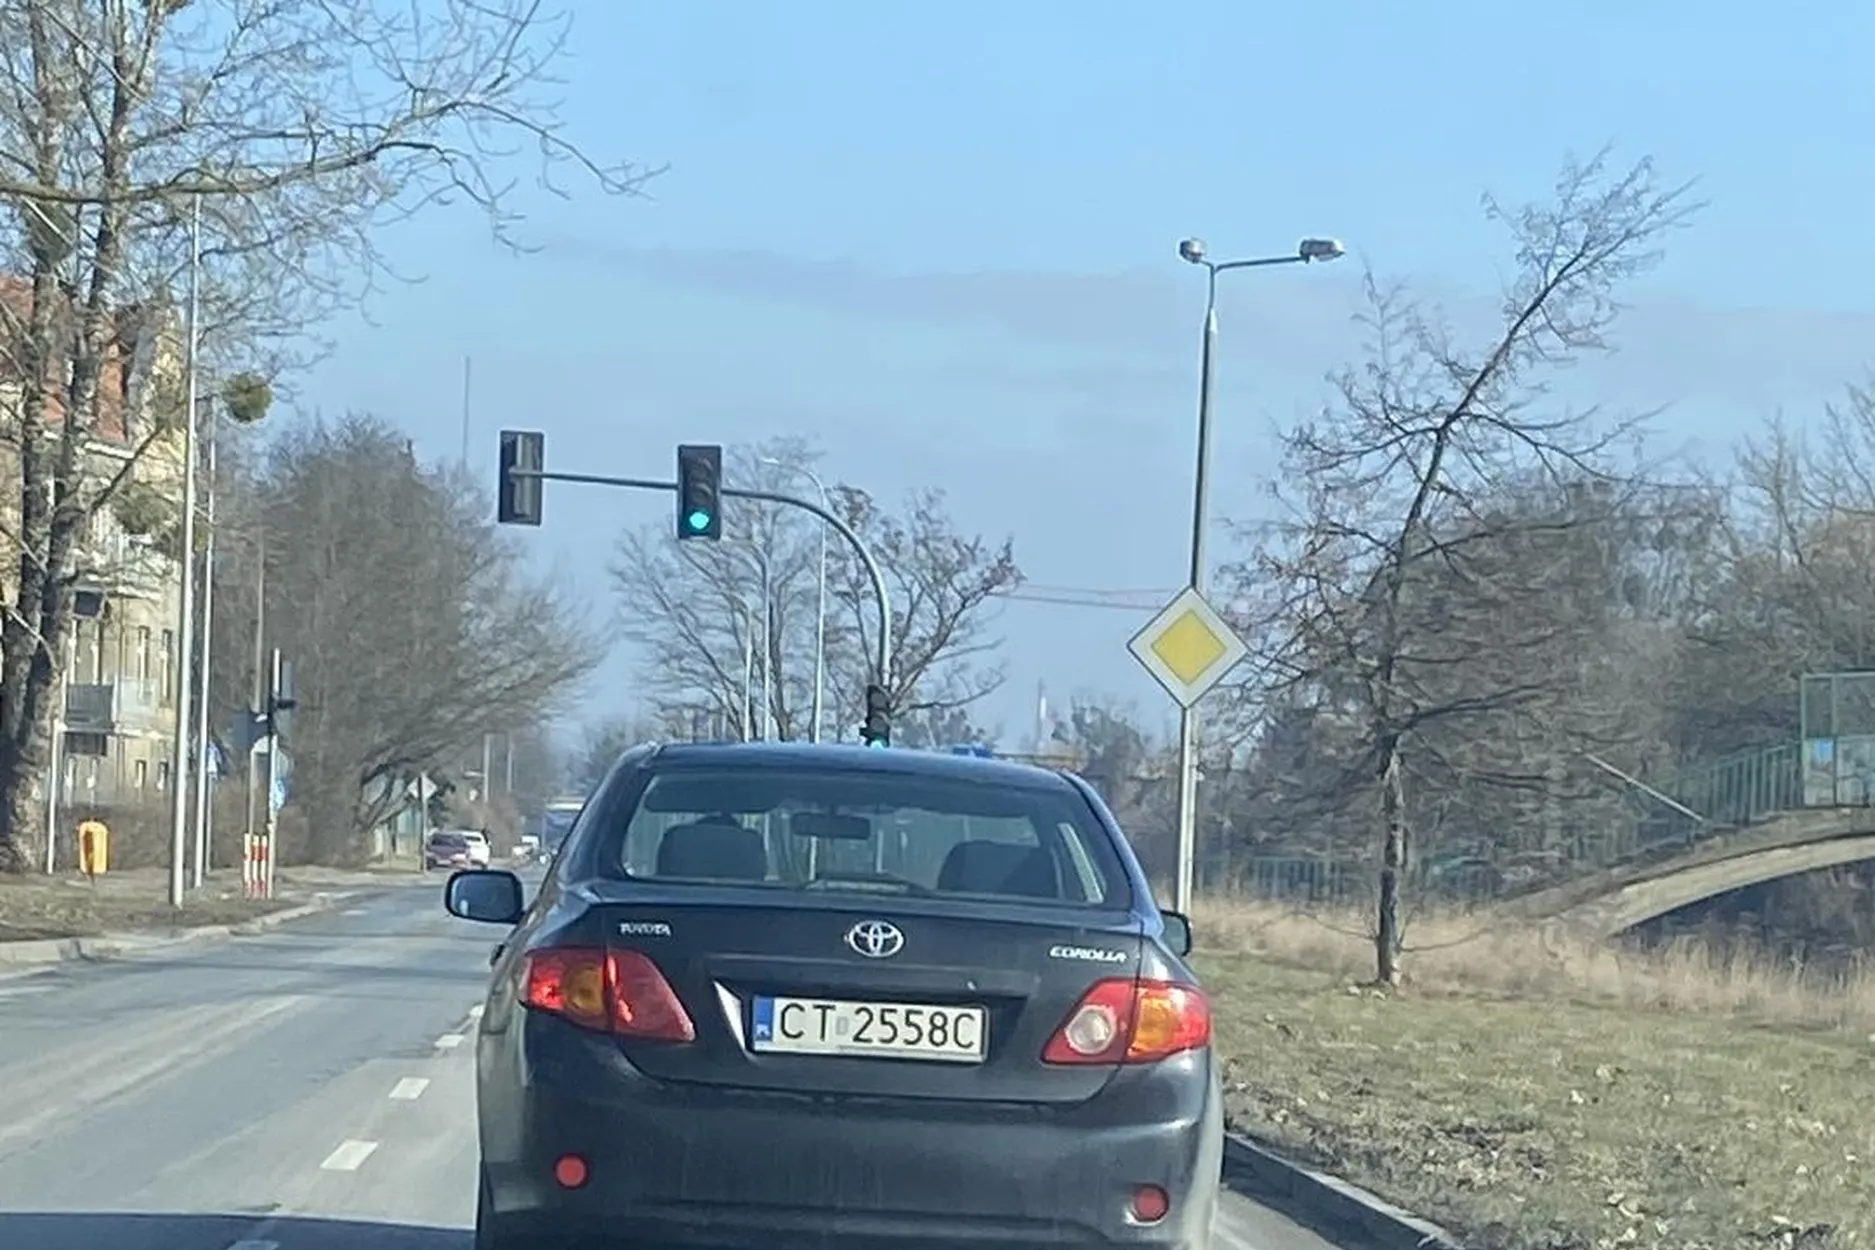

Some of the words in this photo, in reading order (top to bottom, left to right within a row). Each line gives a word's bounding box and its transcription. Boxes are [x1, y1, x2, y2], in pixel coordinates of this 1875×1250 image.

[1050, 946, 1127, 963] COROLLA
[780, 1003, 836, 1041] CT
[852, 1006, 975, 1048] 2558C
